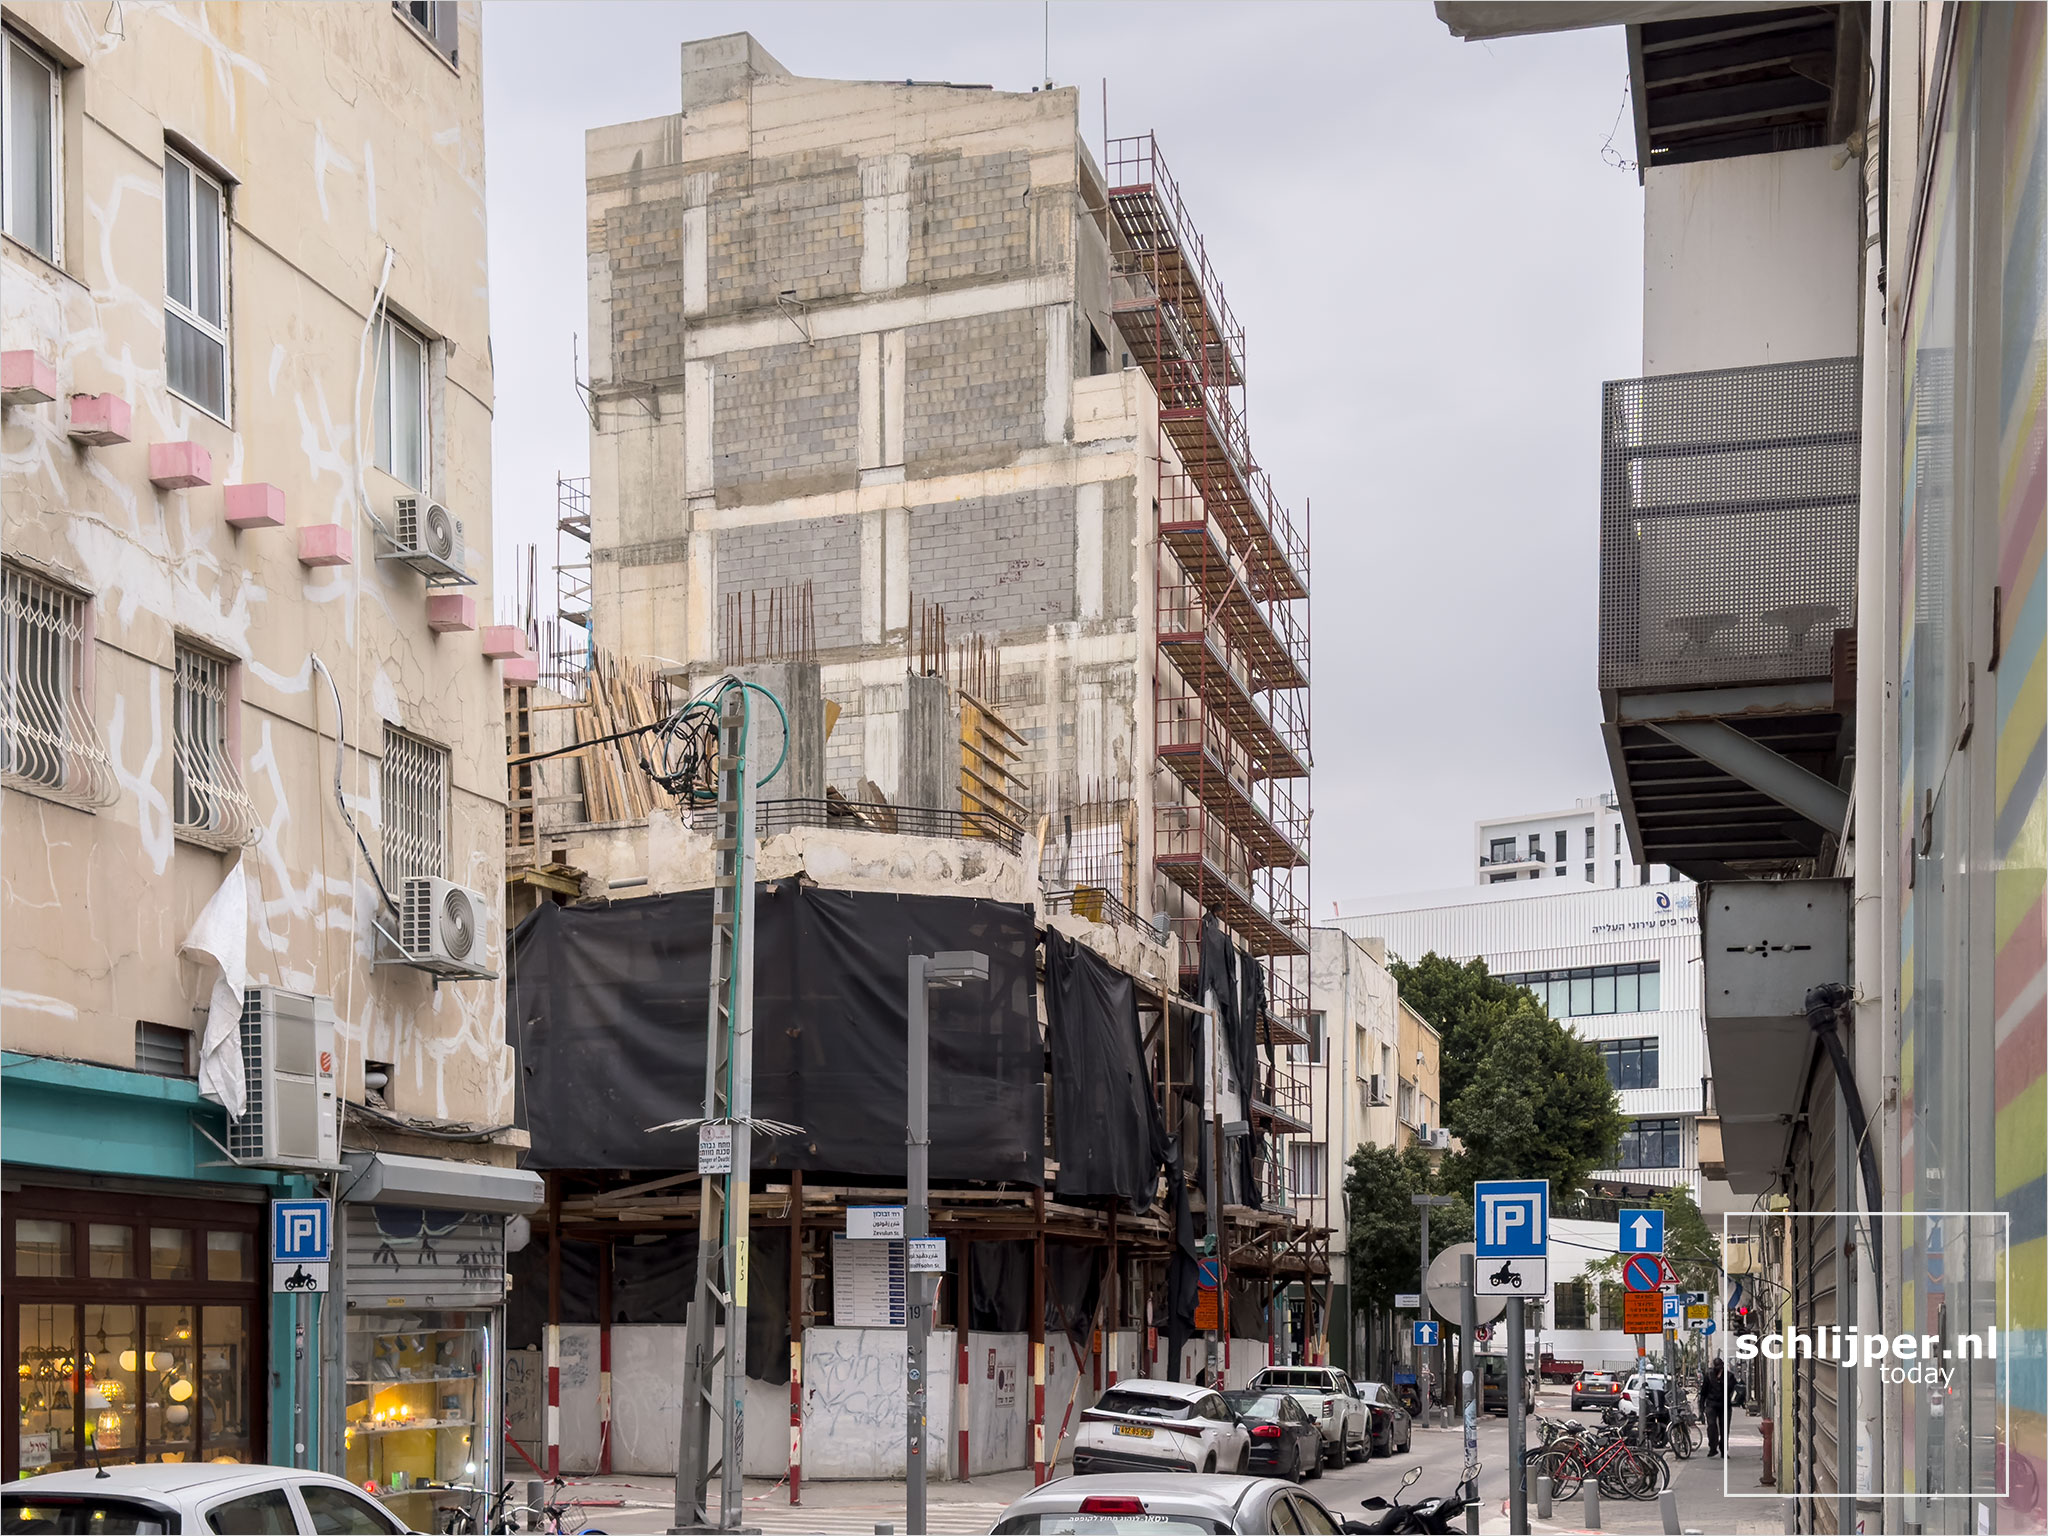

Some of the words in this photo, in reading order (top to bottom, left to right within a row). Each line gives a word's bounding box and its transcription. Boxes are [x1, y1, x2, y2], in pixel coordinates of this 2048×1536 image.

[1628, 920, 1656, 930] עירוני
[1659, 918, 1677, 927] פיס
[1680, 916, 1699, 925] טרי
[1592, 923, 1625, 934] העלייה
[909, 1306, 921, 1319] 19
